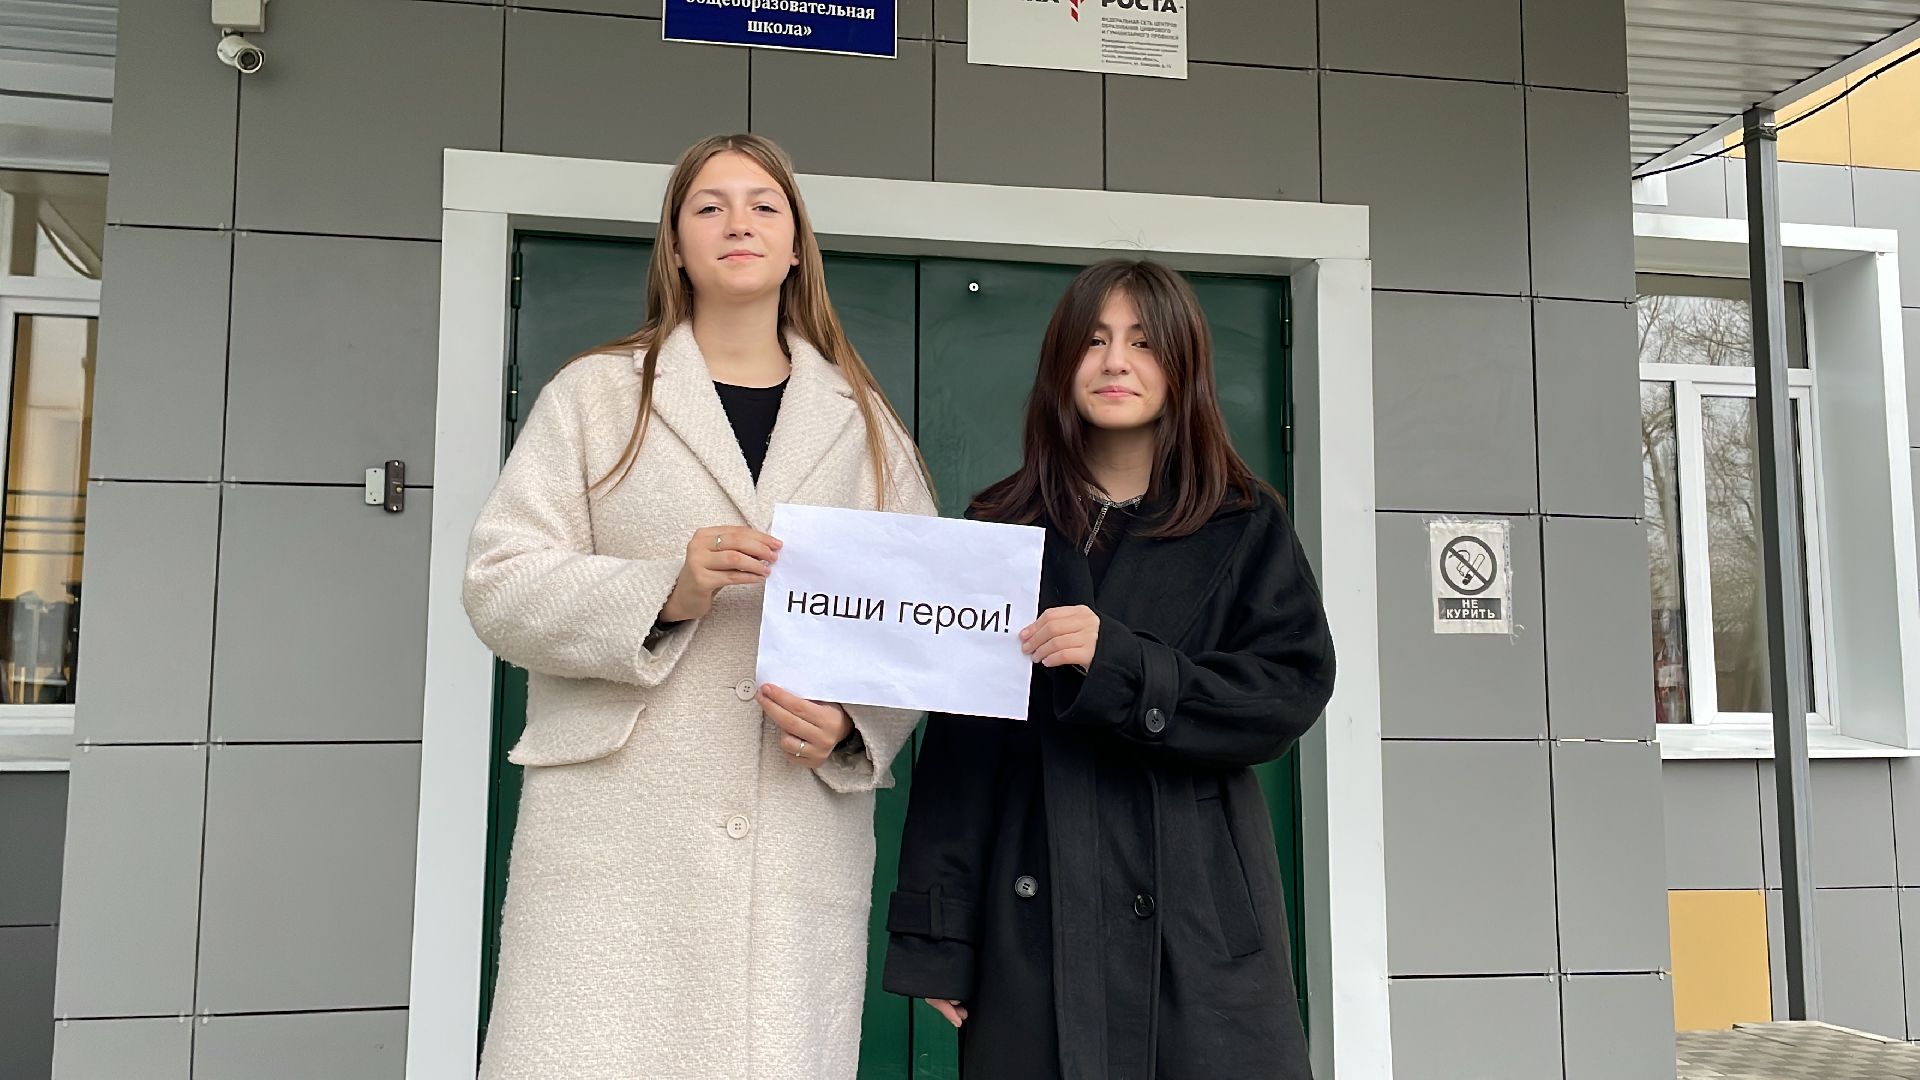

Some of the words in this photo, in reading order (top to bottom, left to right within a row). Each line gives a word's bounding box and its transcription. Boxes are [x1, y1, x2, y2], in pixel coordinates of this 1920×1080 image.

[748, 20, 812, 36] школа»
[1462, 599, 1479, 609] НЕ
[787, 590, 885, 622] наши
[899, 601, 1011, 634] герои!
[1446, 608, 1496, 619] КУРИТЬ
